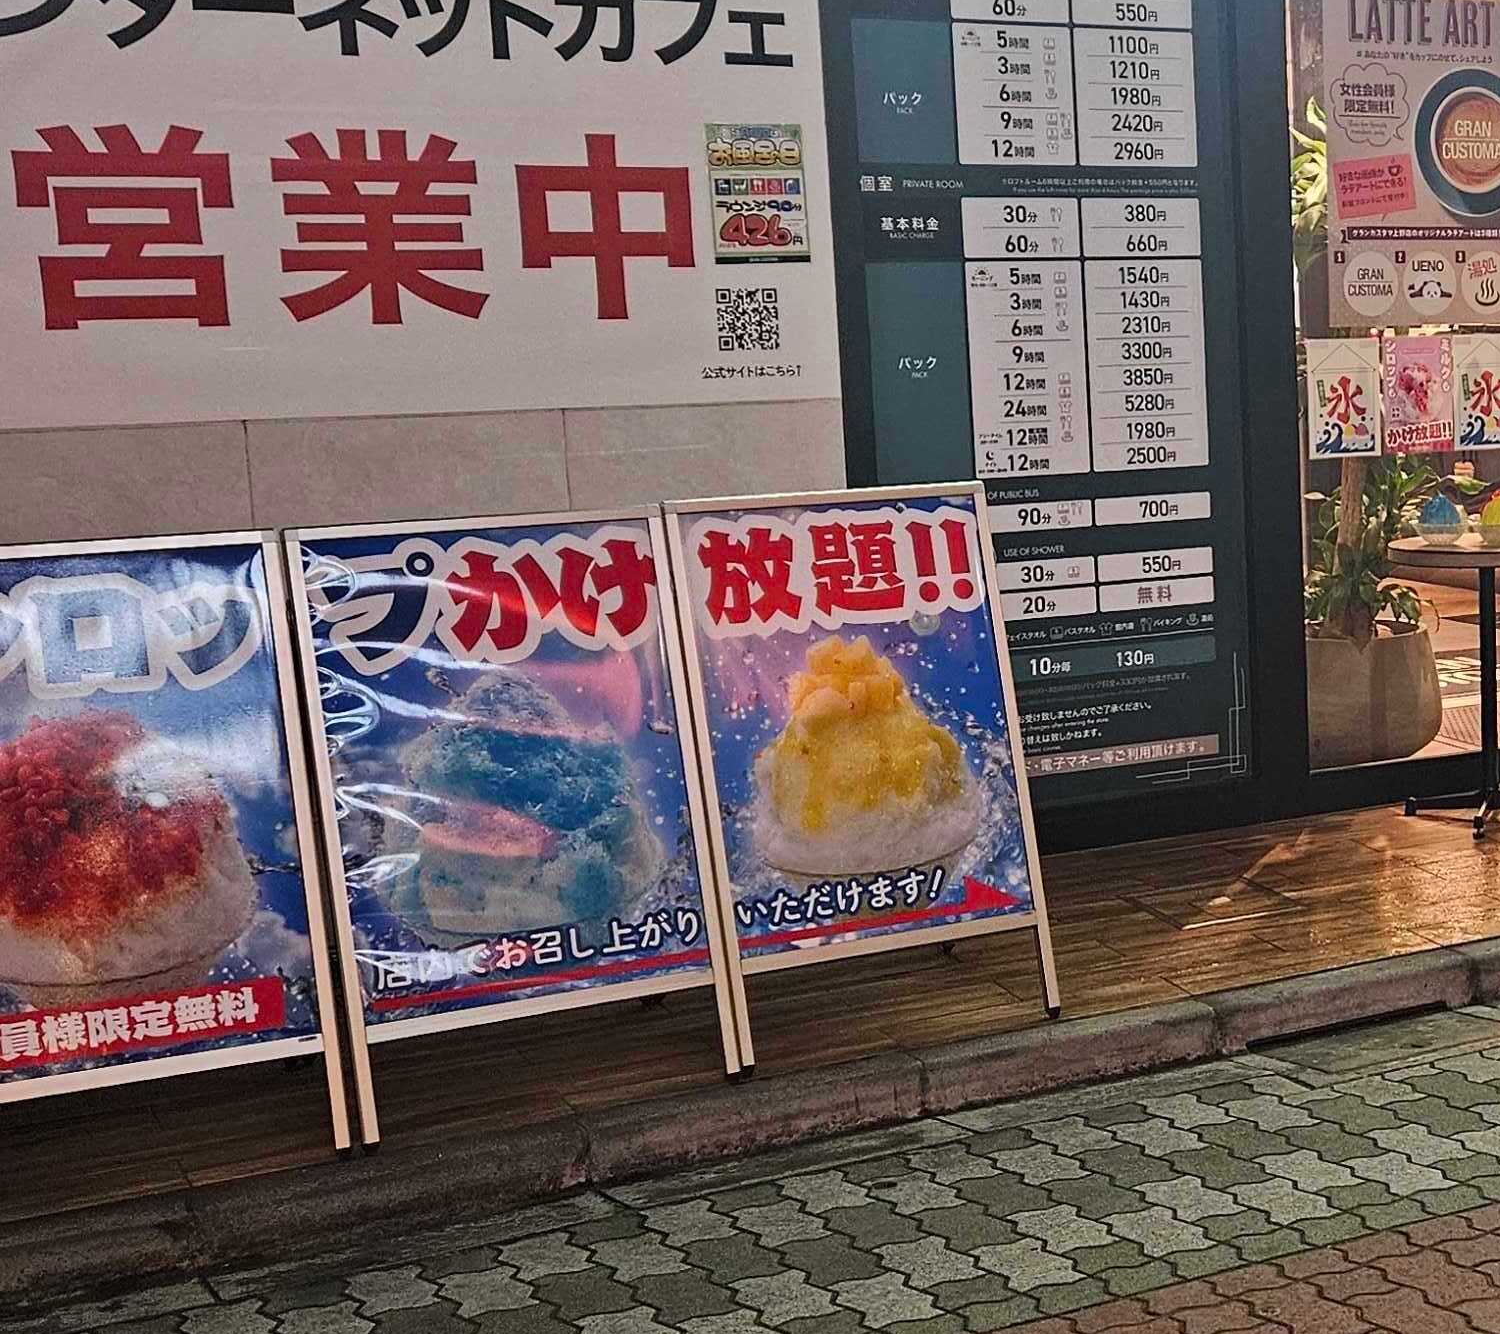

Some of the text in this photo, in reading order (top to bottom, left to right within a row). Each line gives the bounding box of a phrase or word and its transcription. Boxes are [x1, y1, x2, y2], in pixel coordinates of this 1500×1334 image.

[1116, 3, 1158, 22] 550円
[997, 30, 1030, 49] 5時間
[1109, 36, 1159, 55] 1100円
[997, 56, 1160, 80] 3時間 1210円
[883, 91, 922, 105] パック
[1000, 84, 1161, 106] 6時間 1980円
[1339, 82, 1396, 98] 女性会員様
[1344, 98, 1395, 114] 限定無料!
[1001, 112, 1163, 132] 9時間 2420円
[1454, 120, 1492, 138] GRAN
[992, 139, 1164, 160] 12時間 2960円
[860, 175, 964, 192] 個室 PRIVATE ROOM
[880, 216, 939, 231] 基本料金
[1002, 205, 1167, 224] 30分 380円
[11, 124, 695, 331] 営業中
[720, 213, 803, 247] 426円
[1004, 234, 1168, 253] 60分 660円
[1009, 266, 1169, 285] 5時間 1540円
[1357, 268, 1384, 280] GRAN
[1412, 260, 1445, 272] UENO
[1009, 291, 1170, 310] 3時間 1430円
[1347, 284, 1393, 297] CUSTOMA
[1011, 316, 1171, 337] 6時間 2310円
[898, 356, 937, 370] パック
[1012, 342, 1172, 363] 9時間 3300円
[1003, 368, 1173, 391] 12時間 3850円
[1004, 394, 1175, 418] 24時間 5280円
[1326, 375, 1368, 424] 氷
[1006, 427, 1048, 446] 12時間
[1126, 421, 1175, 440] 1980円
[1386, 420, 1453, 447] かけ放題!!
[1007, 446, 1176, 472] 12時間 2500円
[1017, 499, 1178, 527] 90分 700円
[1003, 548, 1019, 557] USE
[1031, 544, 1065, 555] SHOWER
[703, 518, 978, 627] 放題!!
[1020, 555, 1181, 584] 30分 550円
[1022, 583, 1172, 615] 20分 無料
[1116, 649, 1155, 667] 130円
[736, 868, 944, 926] いただけます!
[375, 909, 700, 990] 店内でお召し上がり
